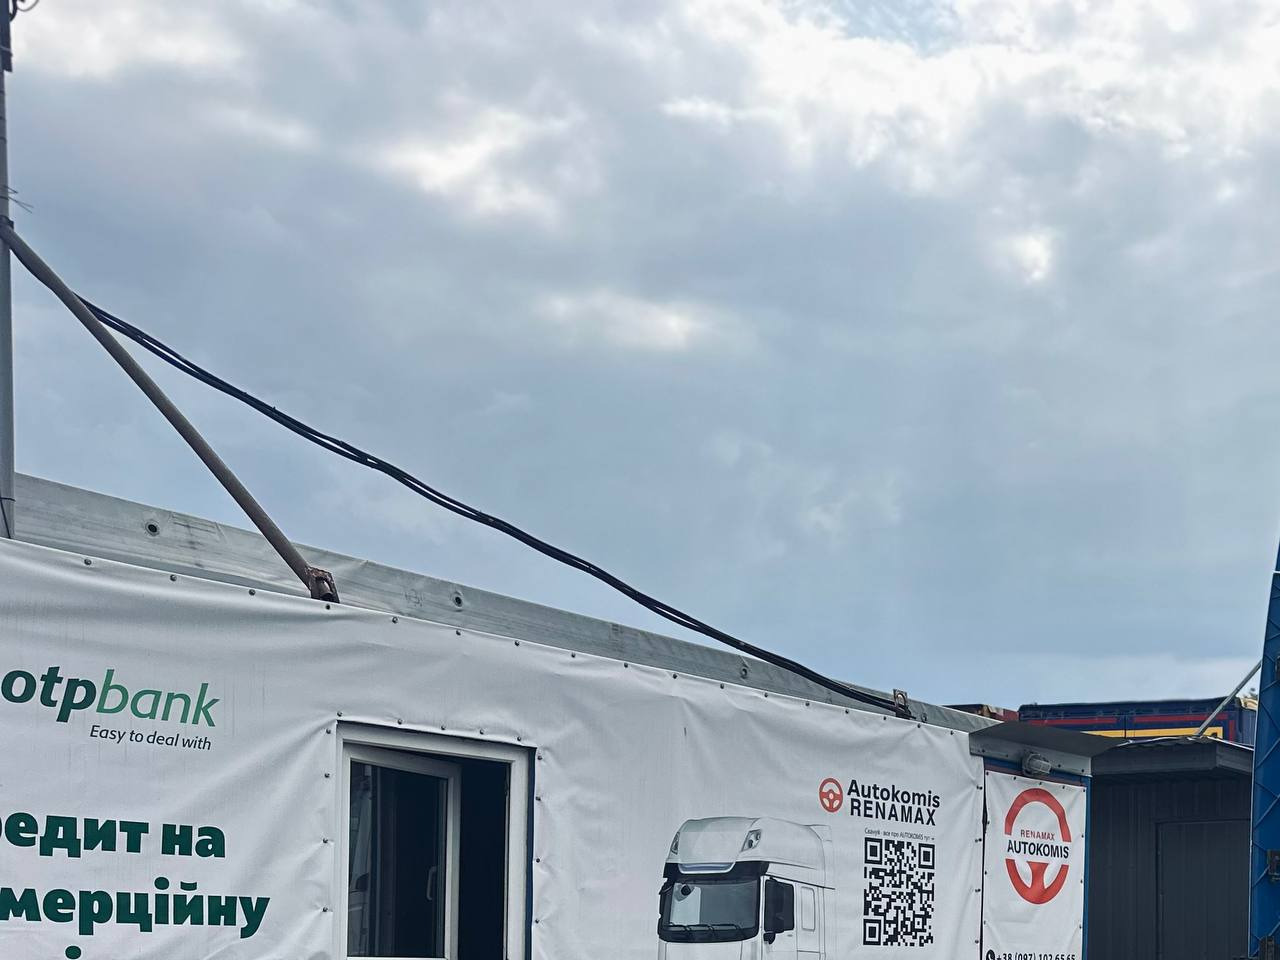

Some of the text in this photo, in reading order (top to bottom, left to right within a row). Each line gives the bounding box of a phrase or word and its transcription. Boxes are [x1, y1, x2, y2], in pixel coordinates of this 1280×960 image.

[1, 666, 220, 727] otpbank
[90, 725, 211, 750] Easy to deal with
[847, 779, 940, 808] Autokomis
[850, 798, 936, 826] RENAMAX
[0, 812, 226, 858] едит на
[1007, 839, 1069, 859] AUTOKOMIS
[1020, 829, 1055, 841] RENAMAX
